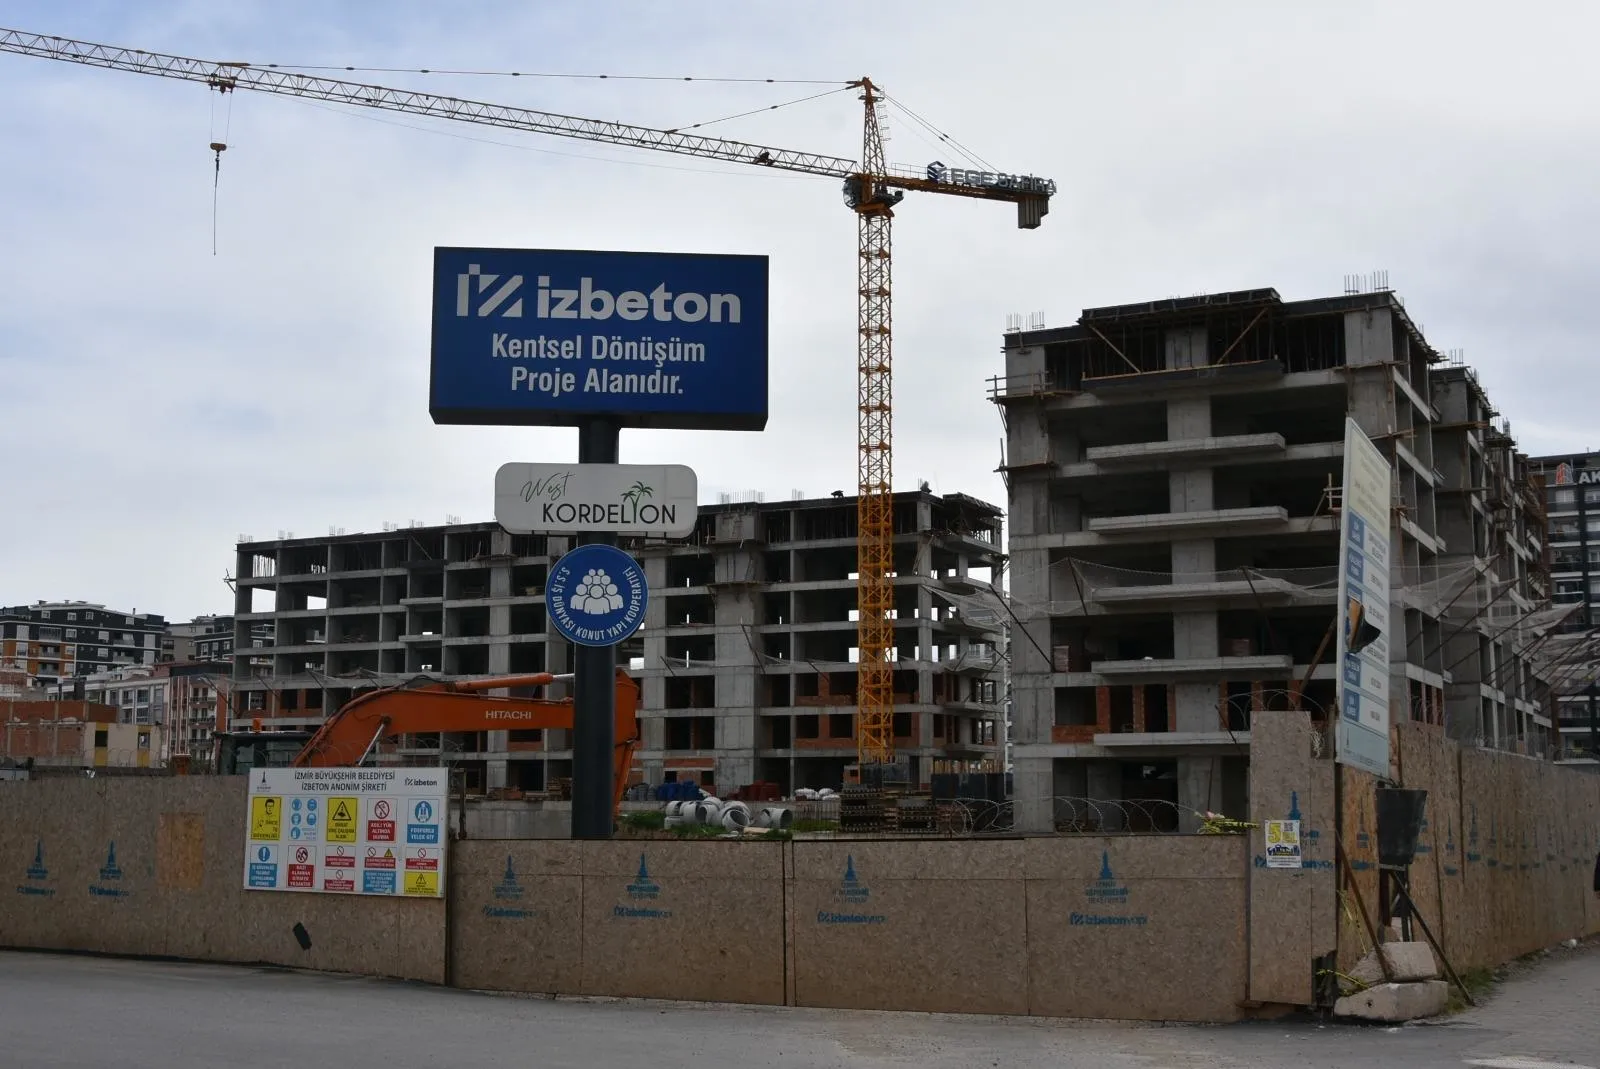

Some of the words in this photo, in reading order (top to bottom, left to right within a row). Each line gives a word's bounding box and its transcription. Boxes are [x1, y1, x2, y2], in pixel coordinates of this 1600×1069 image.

[537, 276, 741, 323] izbeton
[492, 333, 582, 360] Kentsel
[591, 335, 705, 367] Dönüşüm
[511, 367, 575, 397] Proje
[583, 368, 684, 394] Alanıdır.
[520, 471, 576, 502] West
[542, 503, 676, 524] KORDELION
[575, 626, 605, 640] KONUT
[606, 620, 628, 638] YAPI
[485, 710, 532, 720] HITACHI
[294, 770, 314, 780] İZMİR
[315, 770, 356, 781] BÜYÜKŞEHİR
[358, 770, 395, 780] BELEDİYESİ
[413, 778, 438, 787] izbeton
[301, 781, 330, 791] İZBETON
[330, 782, 360, 791] ANONİM
[361, 782, 387, 792] ŞİRKETİ
